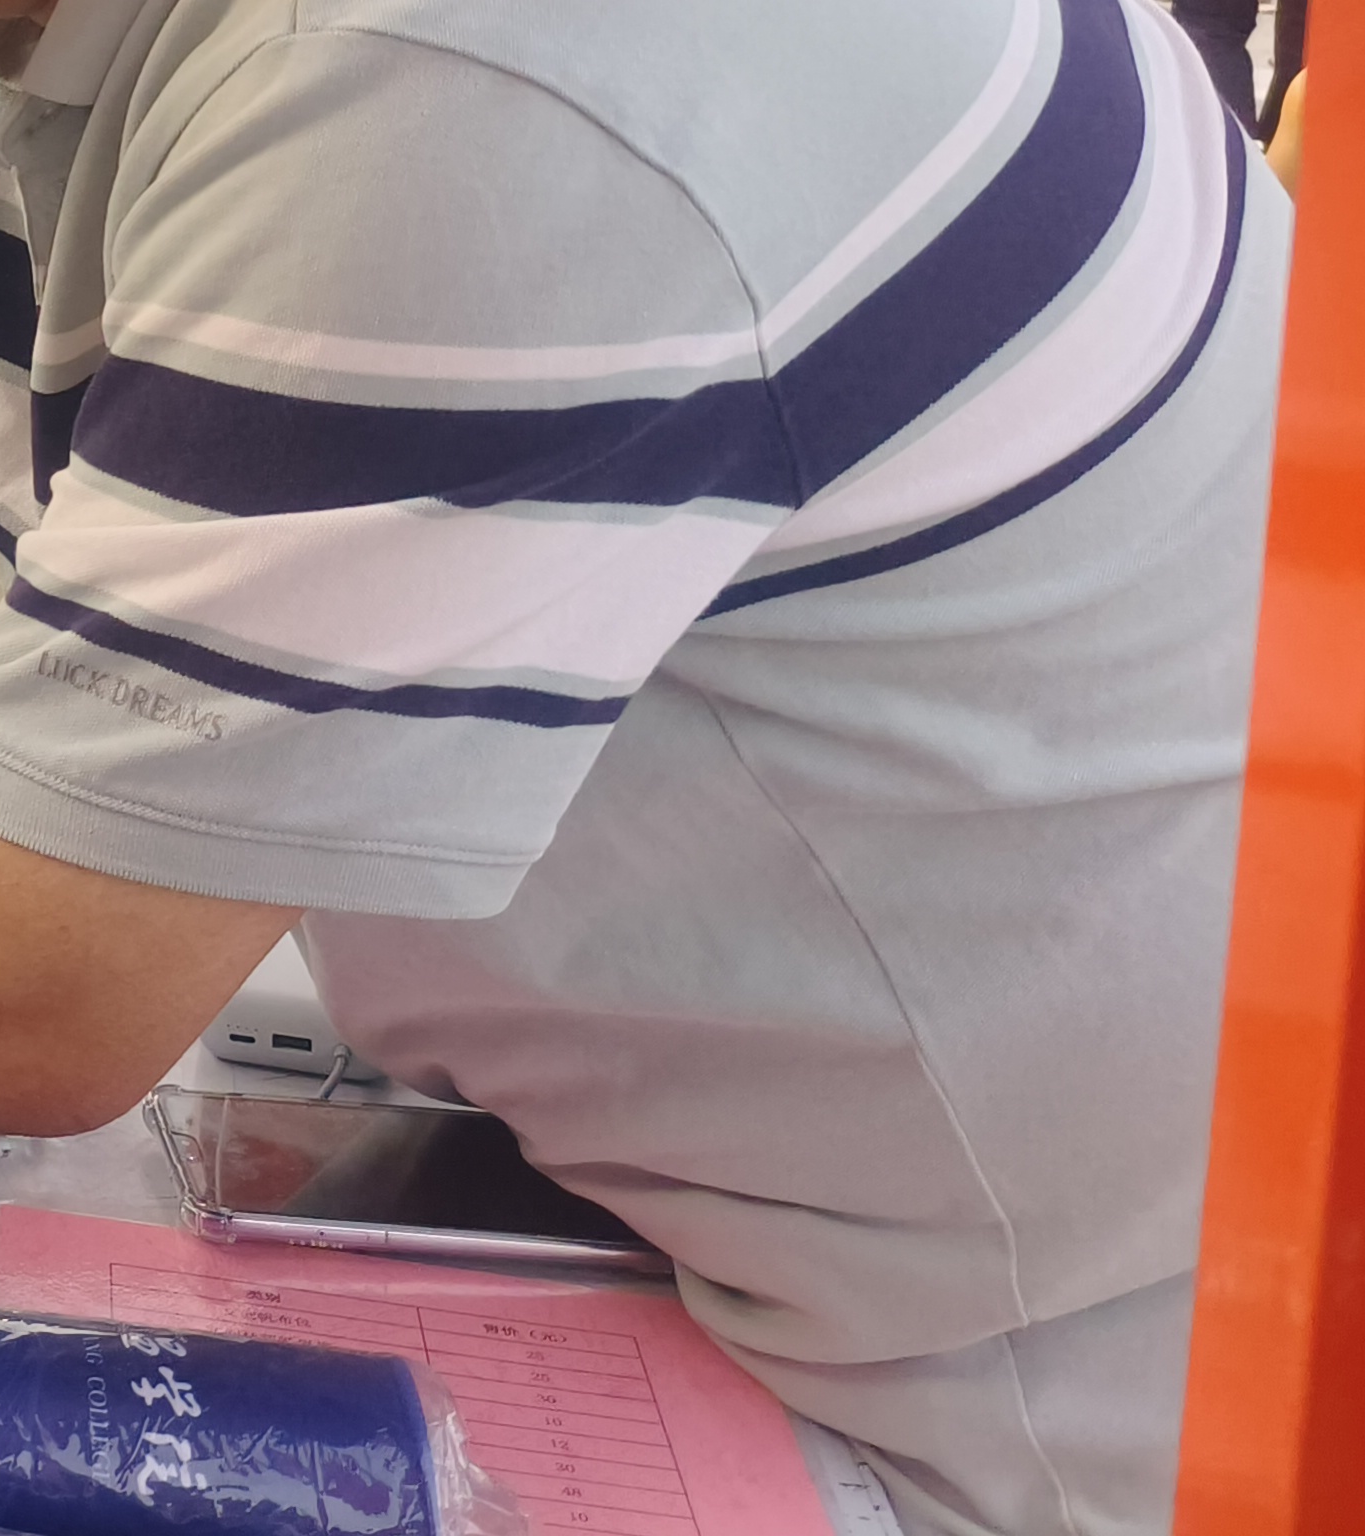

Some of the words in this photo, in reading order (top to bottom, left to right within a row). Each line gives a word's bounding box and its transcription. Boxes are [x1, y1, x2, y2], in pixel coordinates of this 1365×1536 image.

[37, 649, 110, 699] LUCK
[111, 677, 228, 741] DREAMS
[86, 1375, 112, 1485] COLLEGE
[570, 1511, 589, 1523] 10
